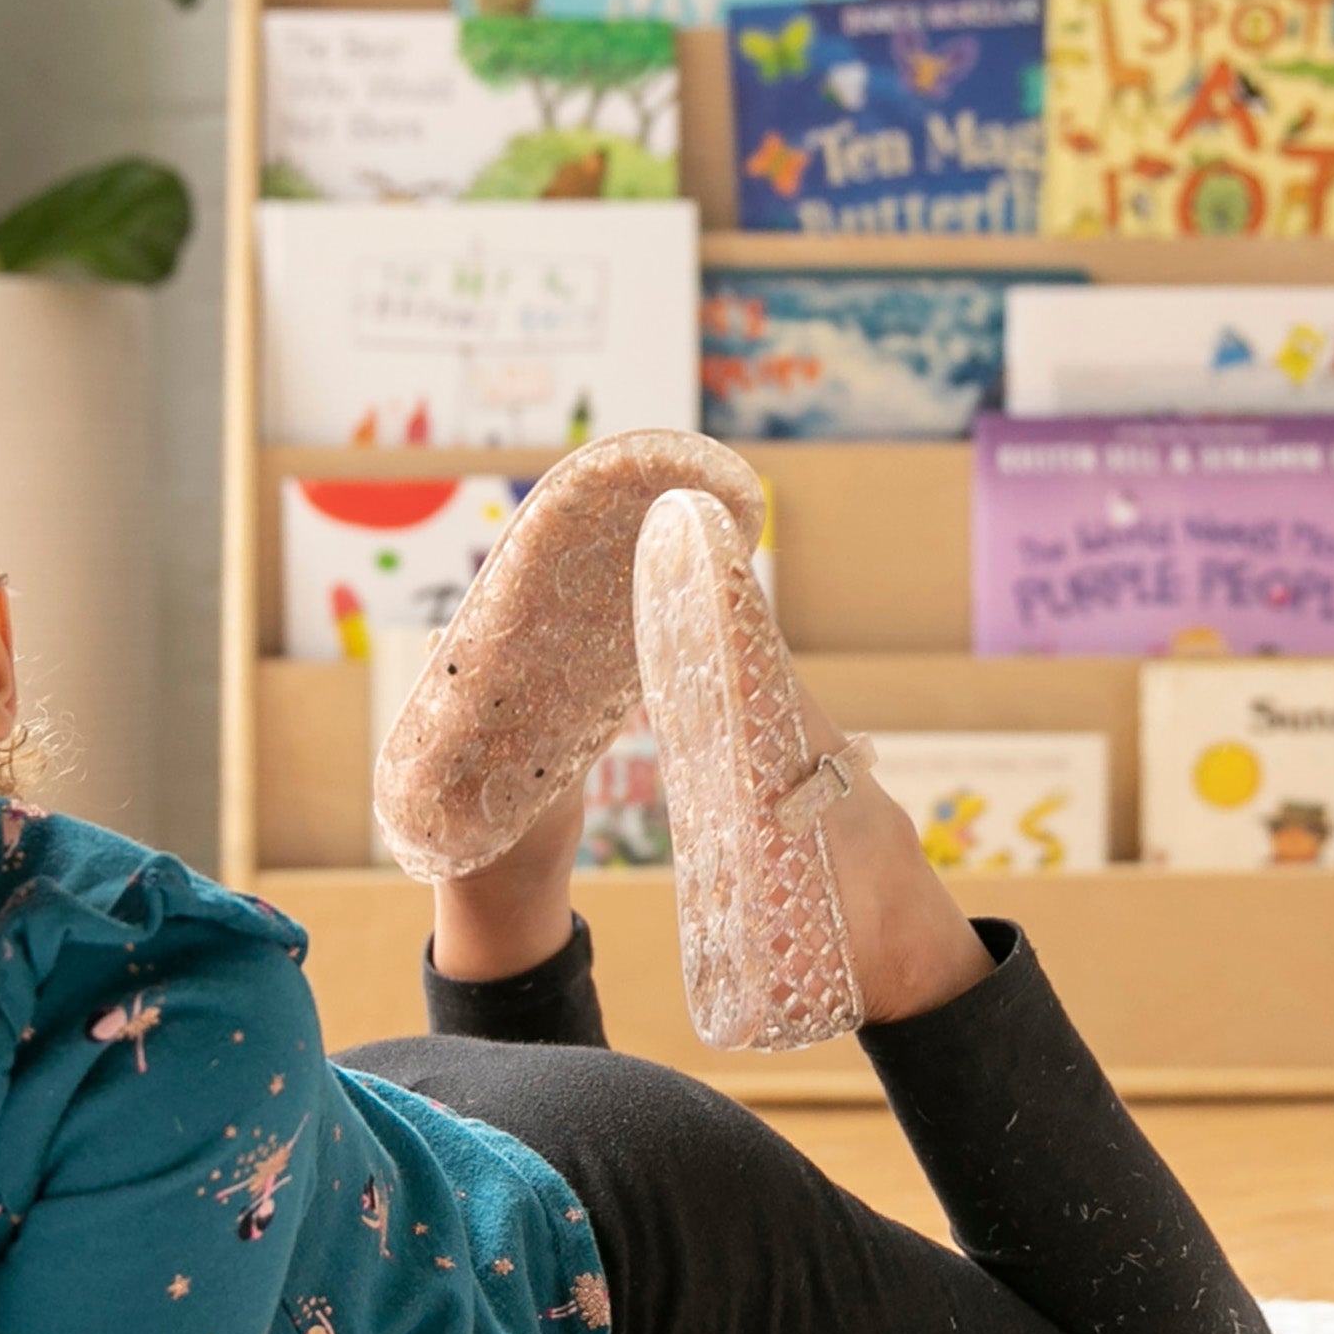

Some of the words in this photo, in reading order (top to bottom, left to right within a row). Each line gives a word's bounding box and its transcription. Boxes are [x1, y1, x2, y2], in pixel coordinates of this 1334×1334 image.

[1170, 58, 1261, 150] A
[803, 117, 915, 189] Ten
[1012, 555, 1181, 627] PURPLE
